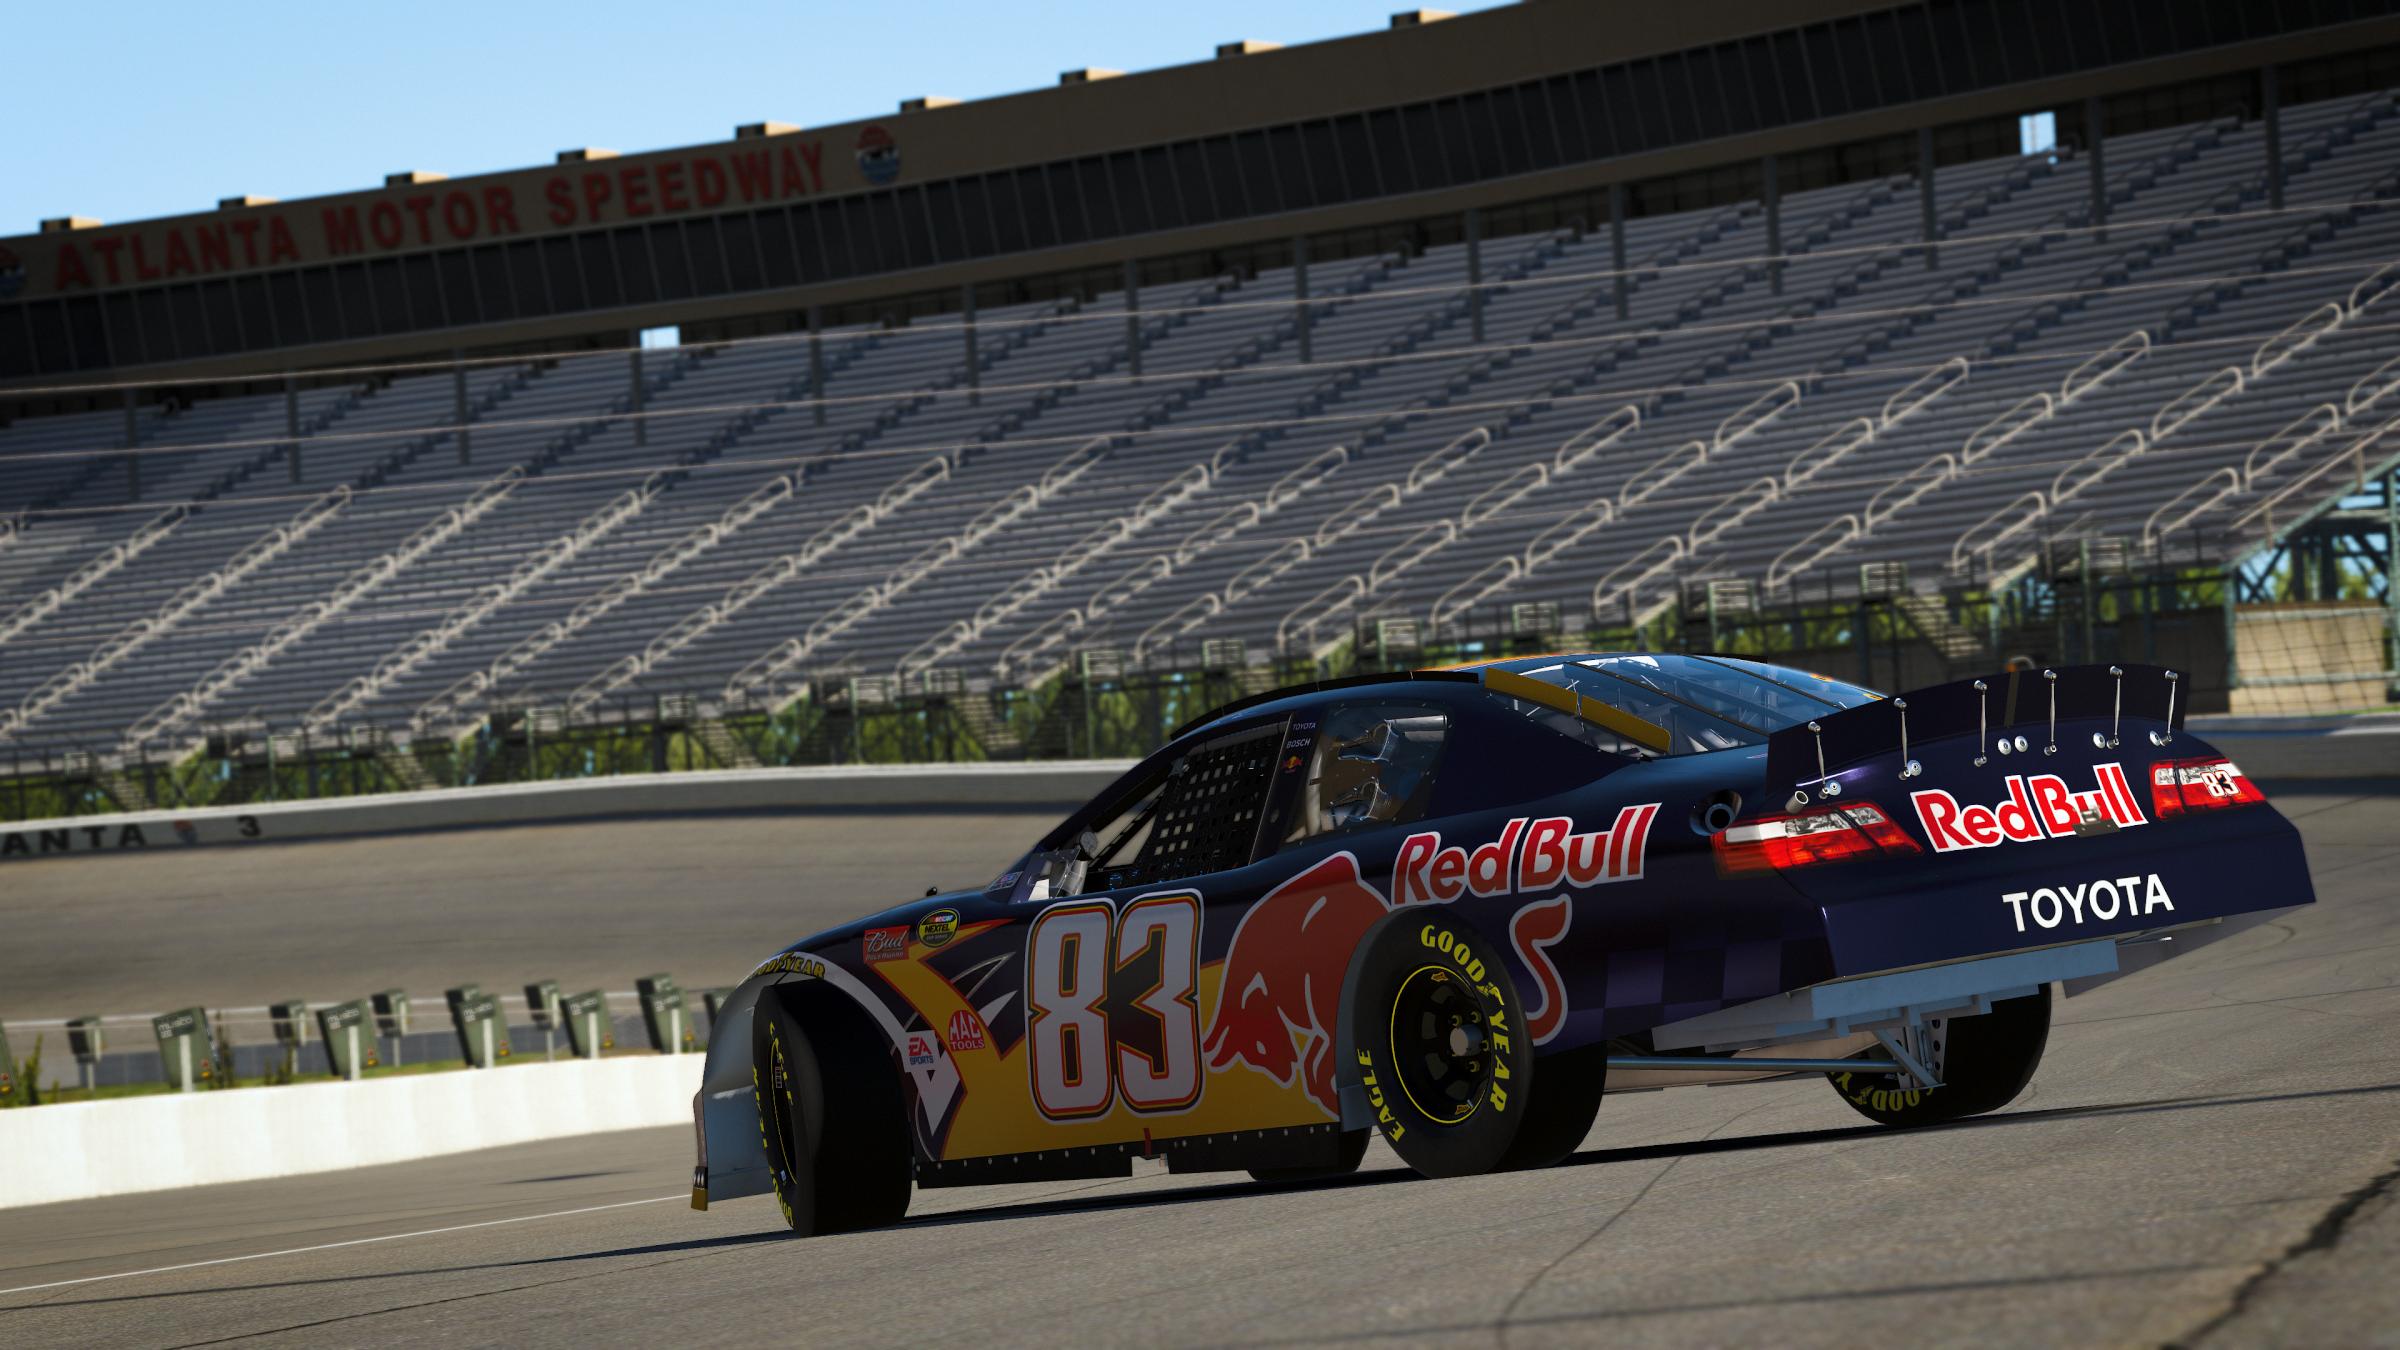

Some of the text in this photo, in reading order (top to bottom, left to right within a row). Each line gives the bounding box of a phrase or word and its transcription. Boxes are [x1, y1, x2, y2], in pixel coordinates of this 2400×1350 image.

[54, 141, 825, 290] ATLANTA MOTOR SPEEDWAY
[1292, 722, 1316, 731] TOYOTA
[1286, 738, 1311, 749] BOSCH
[2200, 770, 2241, 797] 83
[1910, 774, 2045, 853] Red
[1391, 802, 1662, 909] Red Bull
[2002, 873, 2175, 933] TOYOTA
[865, 930, 908, 952] Bud
[924, 923, 949, 934] NEXTEL
[1025, 888, 1204, 1125] 83
[1421, 924, 1510, 1112] GOODYEAR
[950, 1011, 981, 1040] MAC
[908, 1037, 932, 1056] EA
[951, 1039, 985, 1050] TOOLS
[909, 1055, 934, 1065] SPORTS
[1357, 1048, 1406, 1142] EAGLE
